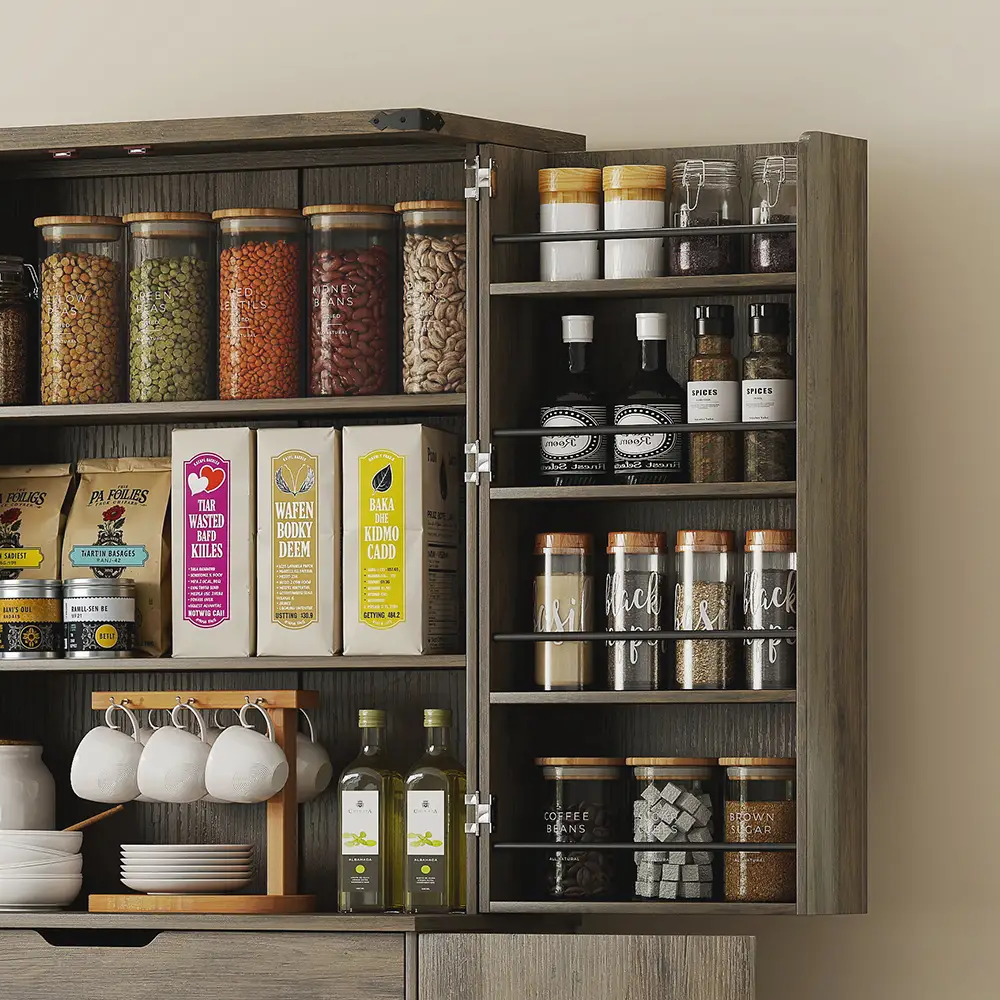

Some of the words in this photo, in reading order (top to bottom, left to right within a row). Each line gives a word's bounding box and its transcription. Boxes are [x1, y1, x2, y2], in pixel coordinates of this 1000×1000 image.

[746, 387, 773, 395] SPICES
[89, 490, 104, 504] PA
[275, 501, 314, 519] WAFEN
[369, 498, 395, 511] BAKA
[188, 514, 225, 529] WASTED
[277, 521, 313, 539] BODKY
[364, 526, 400, 542] KIDMO
[278, 541, 311, 558] DEEM
[367, 543, 396, 560] CADD
[544, 811, 590, 821] COFFEE
[729, 812, 775, 822] BROWN
[546, 824, 587, 833] BEANS
